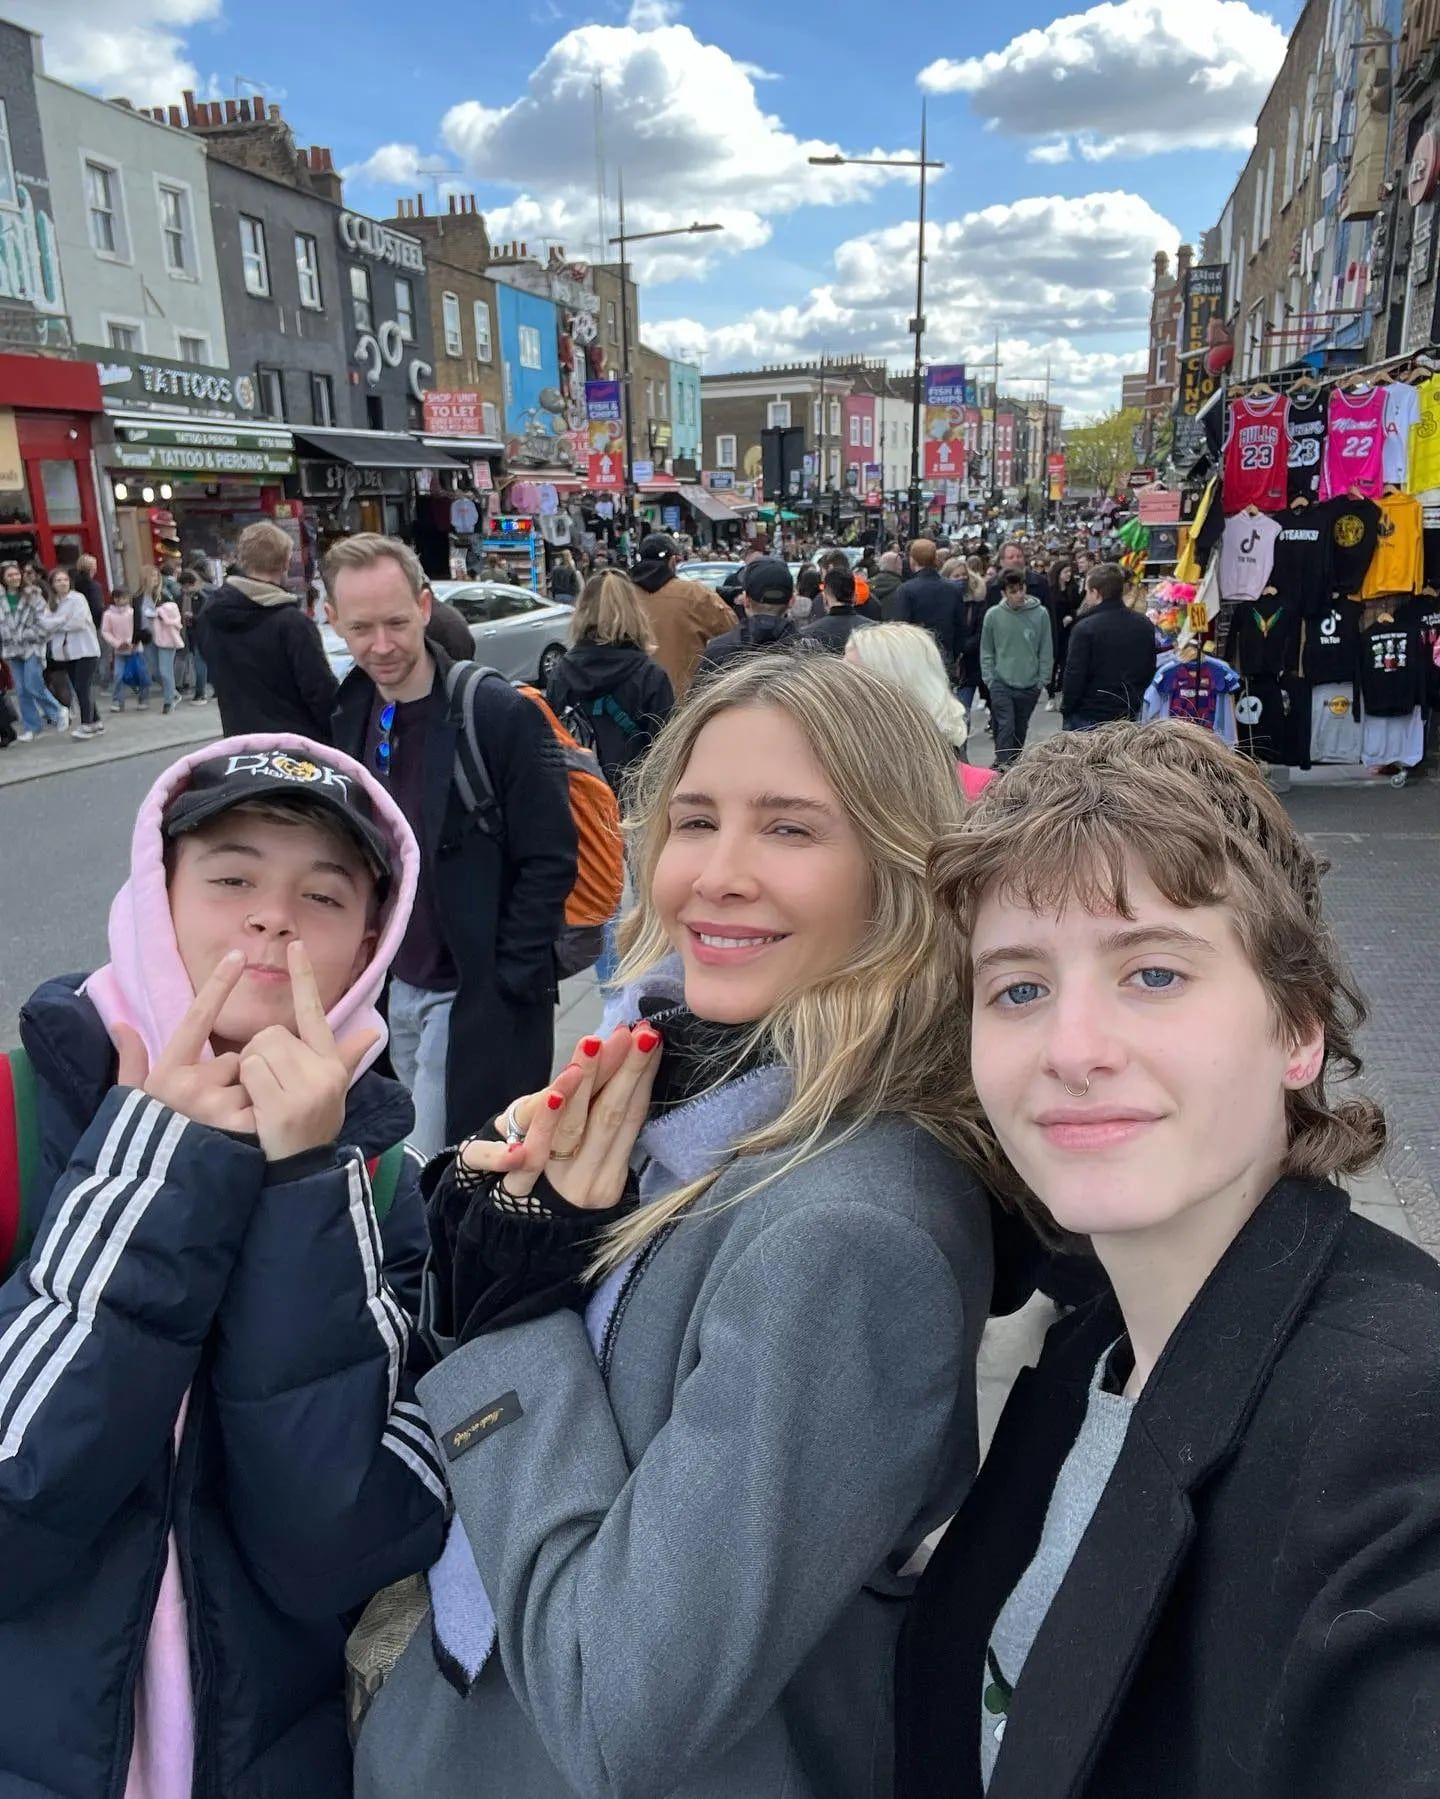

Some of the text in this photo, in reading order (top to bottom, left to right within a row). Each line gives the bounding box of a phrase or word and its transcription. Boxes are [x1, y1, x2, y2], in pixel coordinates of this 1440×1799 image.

[139, 365, 233, 403] TATTOOS
[928, 387, 952, 395] FISH
[928, 395, 962, 405] CHIPS
[431, 405, 477, 417] TO LET
[1239, 424, 1279, 448] BULLS
[1342, 436, 1373, 457] 22
[159, 449, 204, 468] TATTOO
[205, 451, 214, 468] &
[215, 451, 264, 470] PIERCING
[1242, 444, 1274, 470] 23
[1288, 438, 1321, 468] 23
